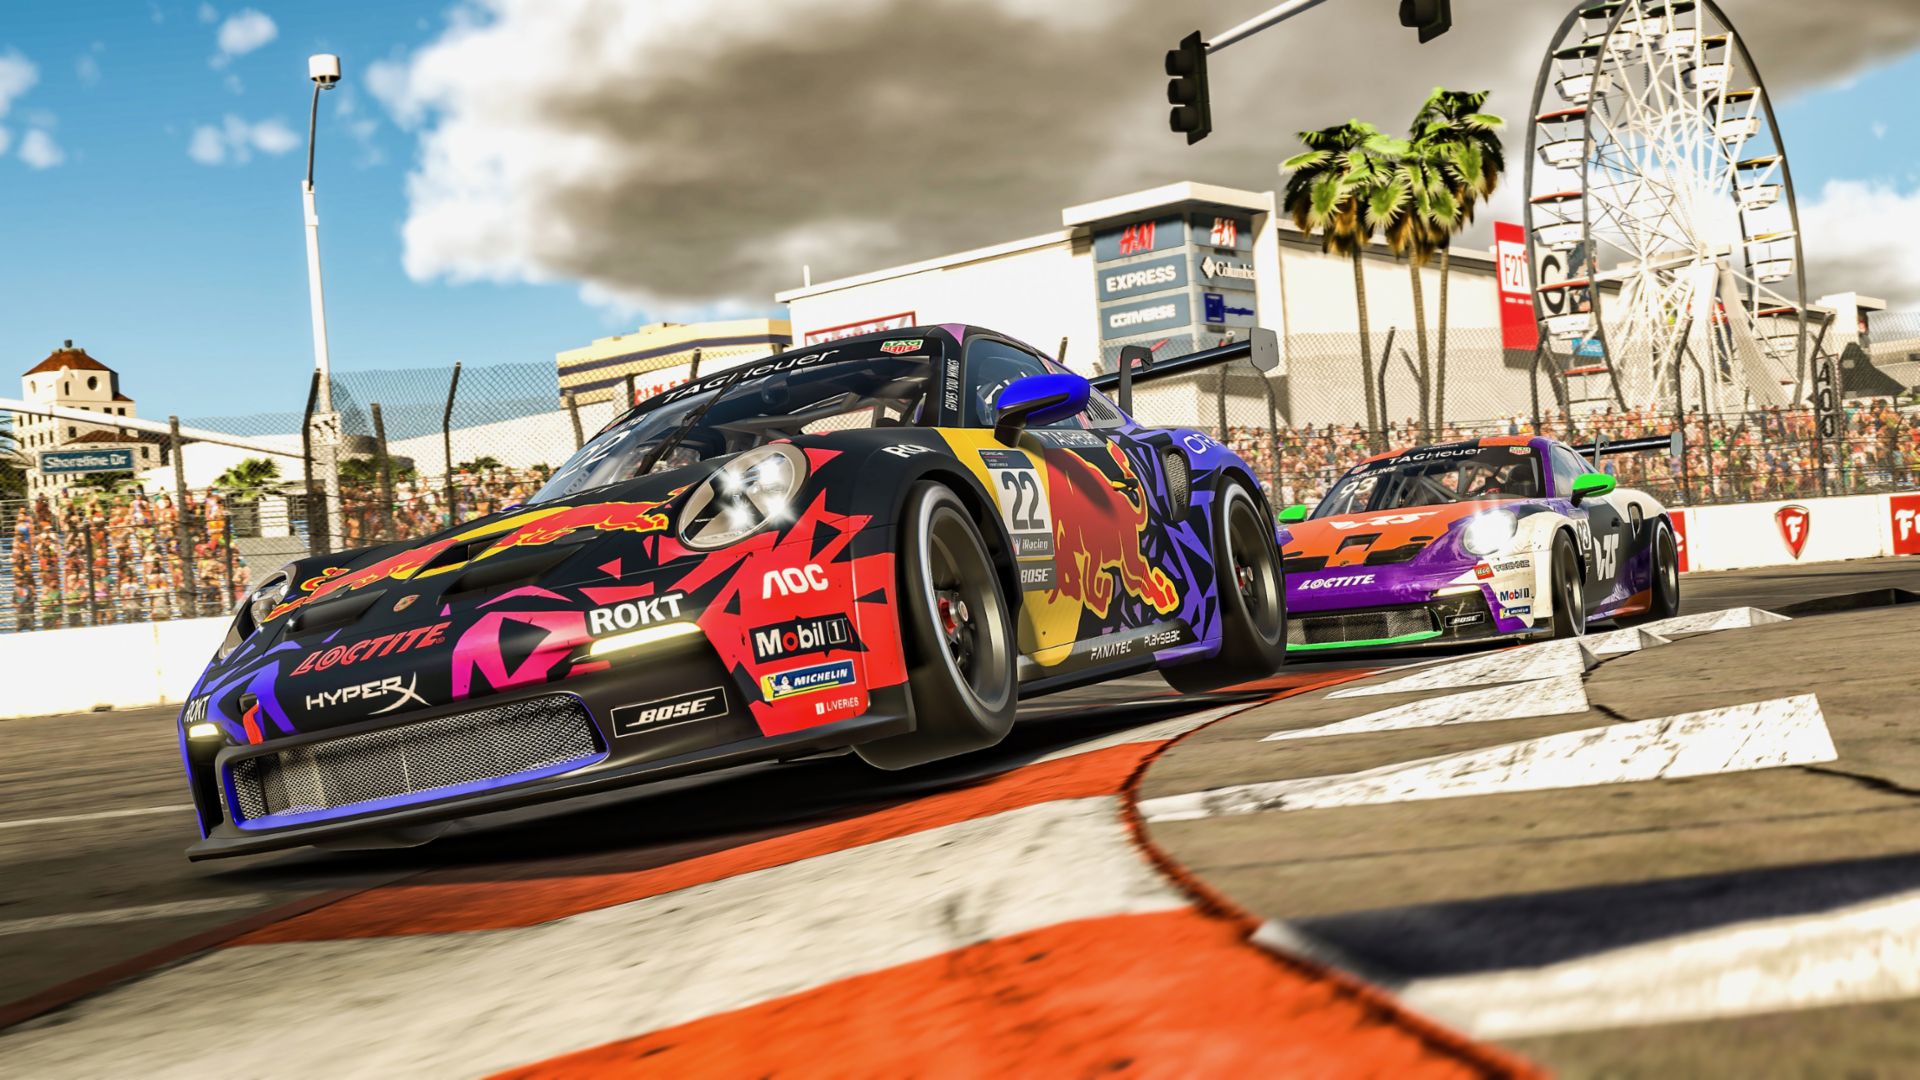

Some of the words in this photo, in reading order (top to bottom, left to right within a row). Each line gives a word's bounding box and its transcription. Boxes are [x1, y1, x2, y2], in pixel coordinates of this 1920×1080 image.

[1106, 265, 1177, 293] EXPRESS
[1109, 304, 1176, 328] CONVERSE
[946, 358, 960, 379] WINGS
[945, 377, 959, 393] YOU
[944, 391, 959, 412] GIVES
[44, 455, 109, 469] Shoreline
[109, 453, 127, 466] Dr
[1001, 471, 1045, 530] 22
[1339, 477, 1378, 503] 93
[762, 563, 829, 600] AOC
[1020, 567, 1052, 584] BOSE
[1297, 573, 1376, 591] LOCTITE
[1500, 588, 1523, 602] Mobil
[589, 592, 684, 635] ROKT
[289, 621, 452, 677] LOCTITE
[755, 621, 826, 657] Mobil
[1090, 640, 1133, 661] FANATEC
[794, 668, 848, 688] MICHELIN
[626, 696, 716, 727] BOSE
